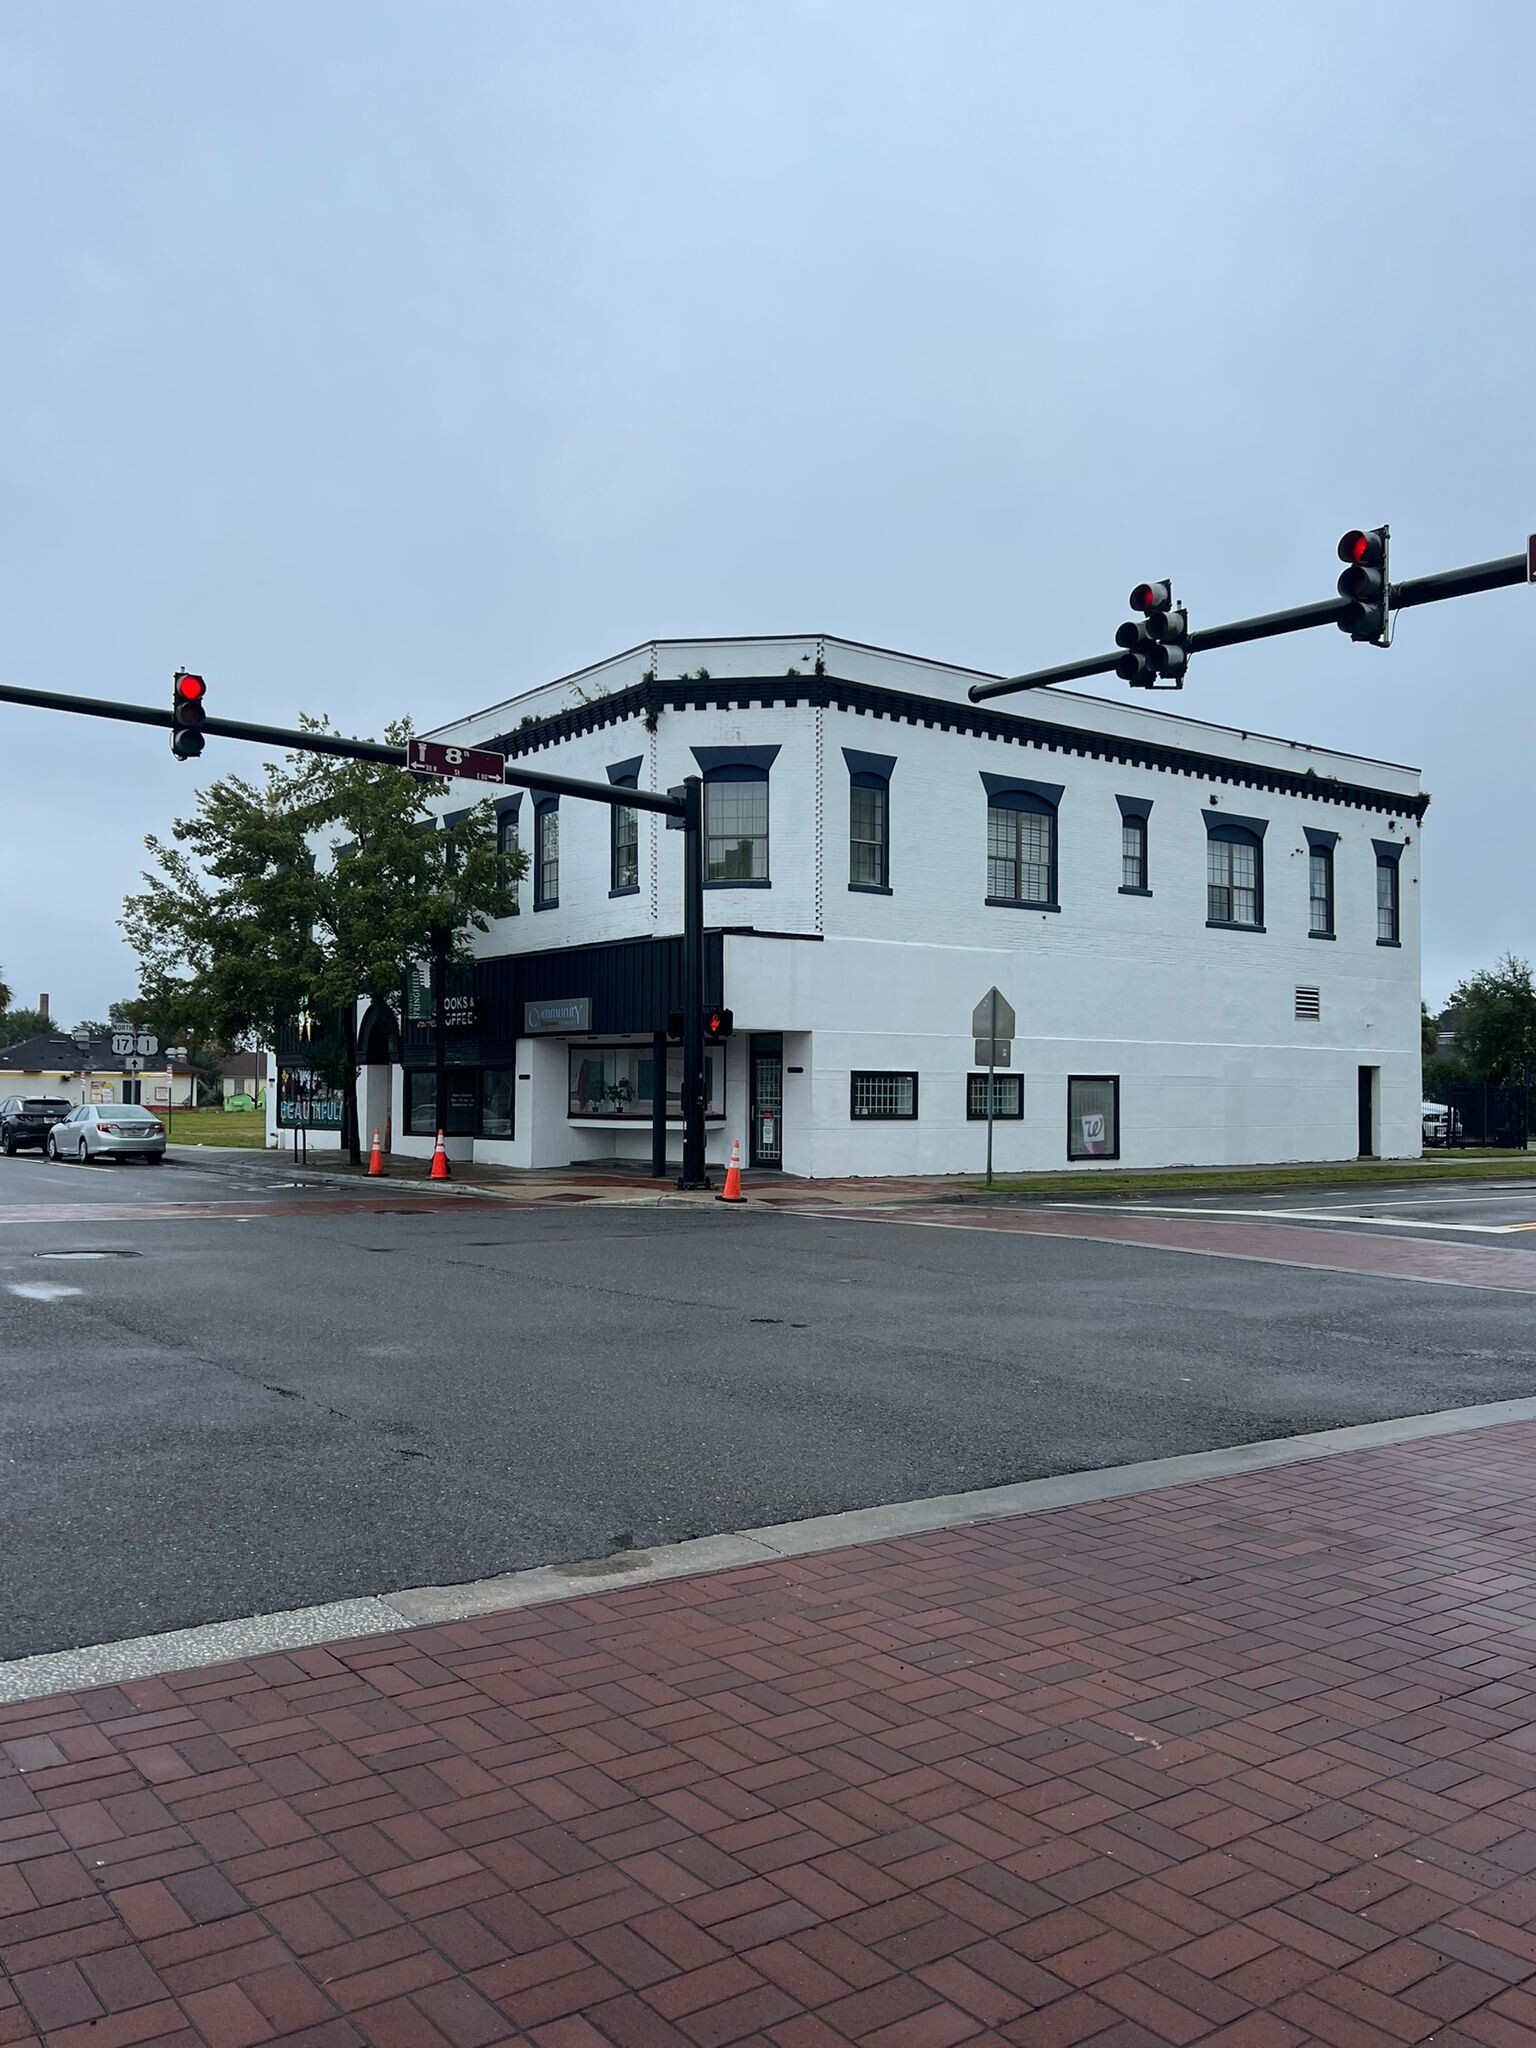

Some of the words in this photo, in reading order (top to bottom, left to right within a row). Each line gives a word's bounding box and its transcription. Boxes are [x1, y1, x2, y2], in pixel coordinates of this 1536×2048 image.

[444, 996, 468, 1010] OOKS
[445, 1012, 473, 1026] OFFEE
[117, 1039, 129, 1051] 17
